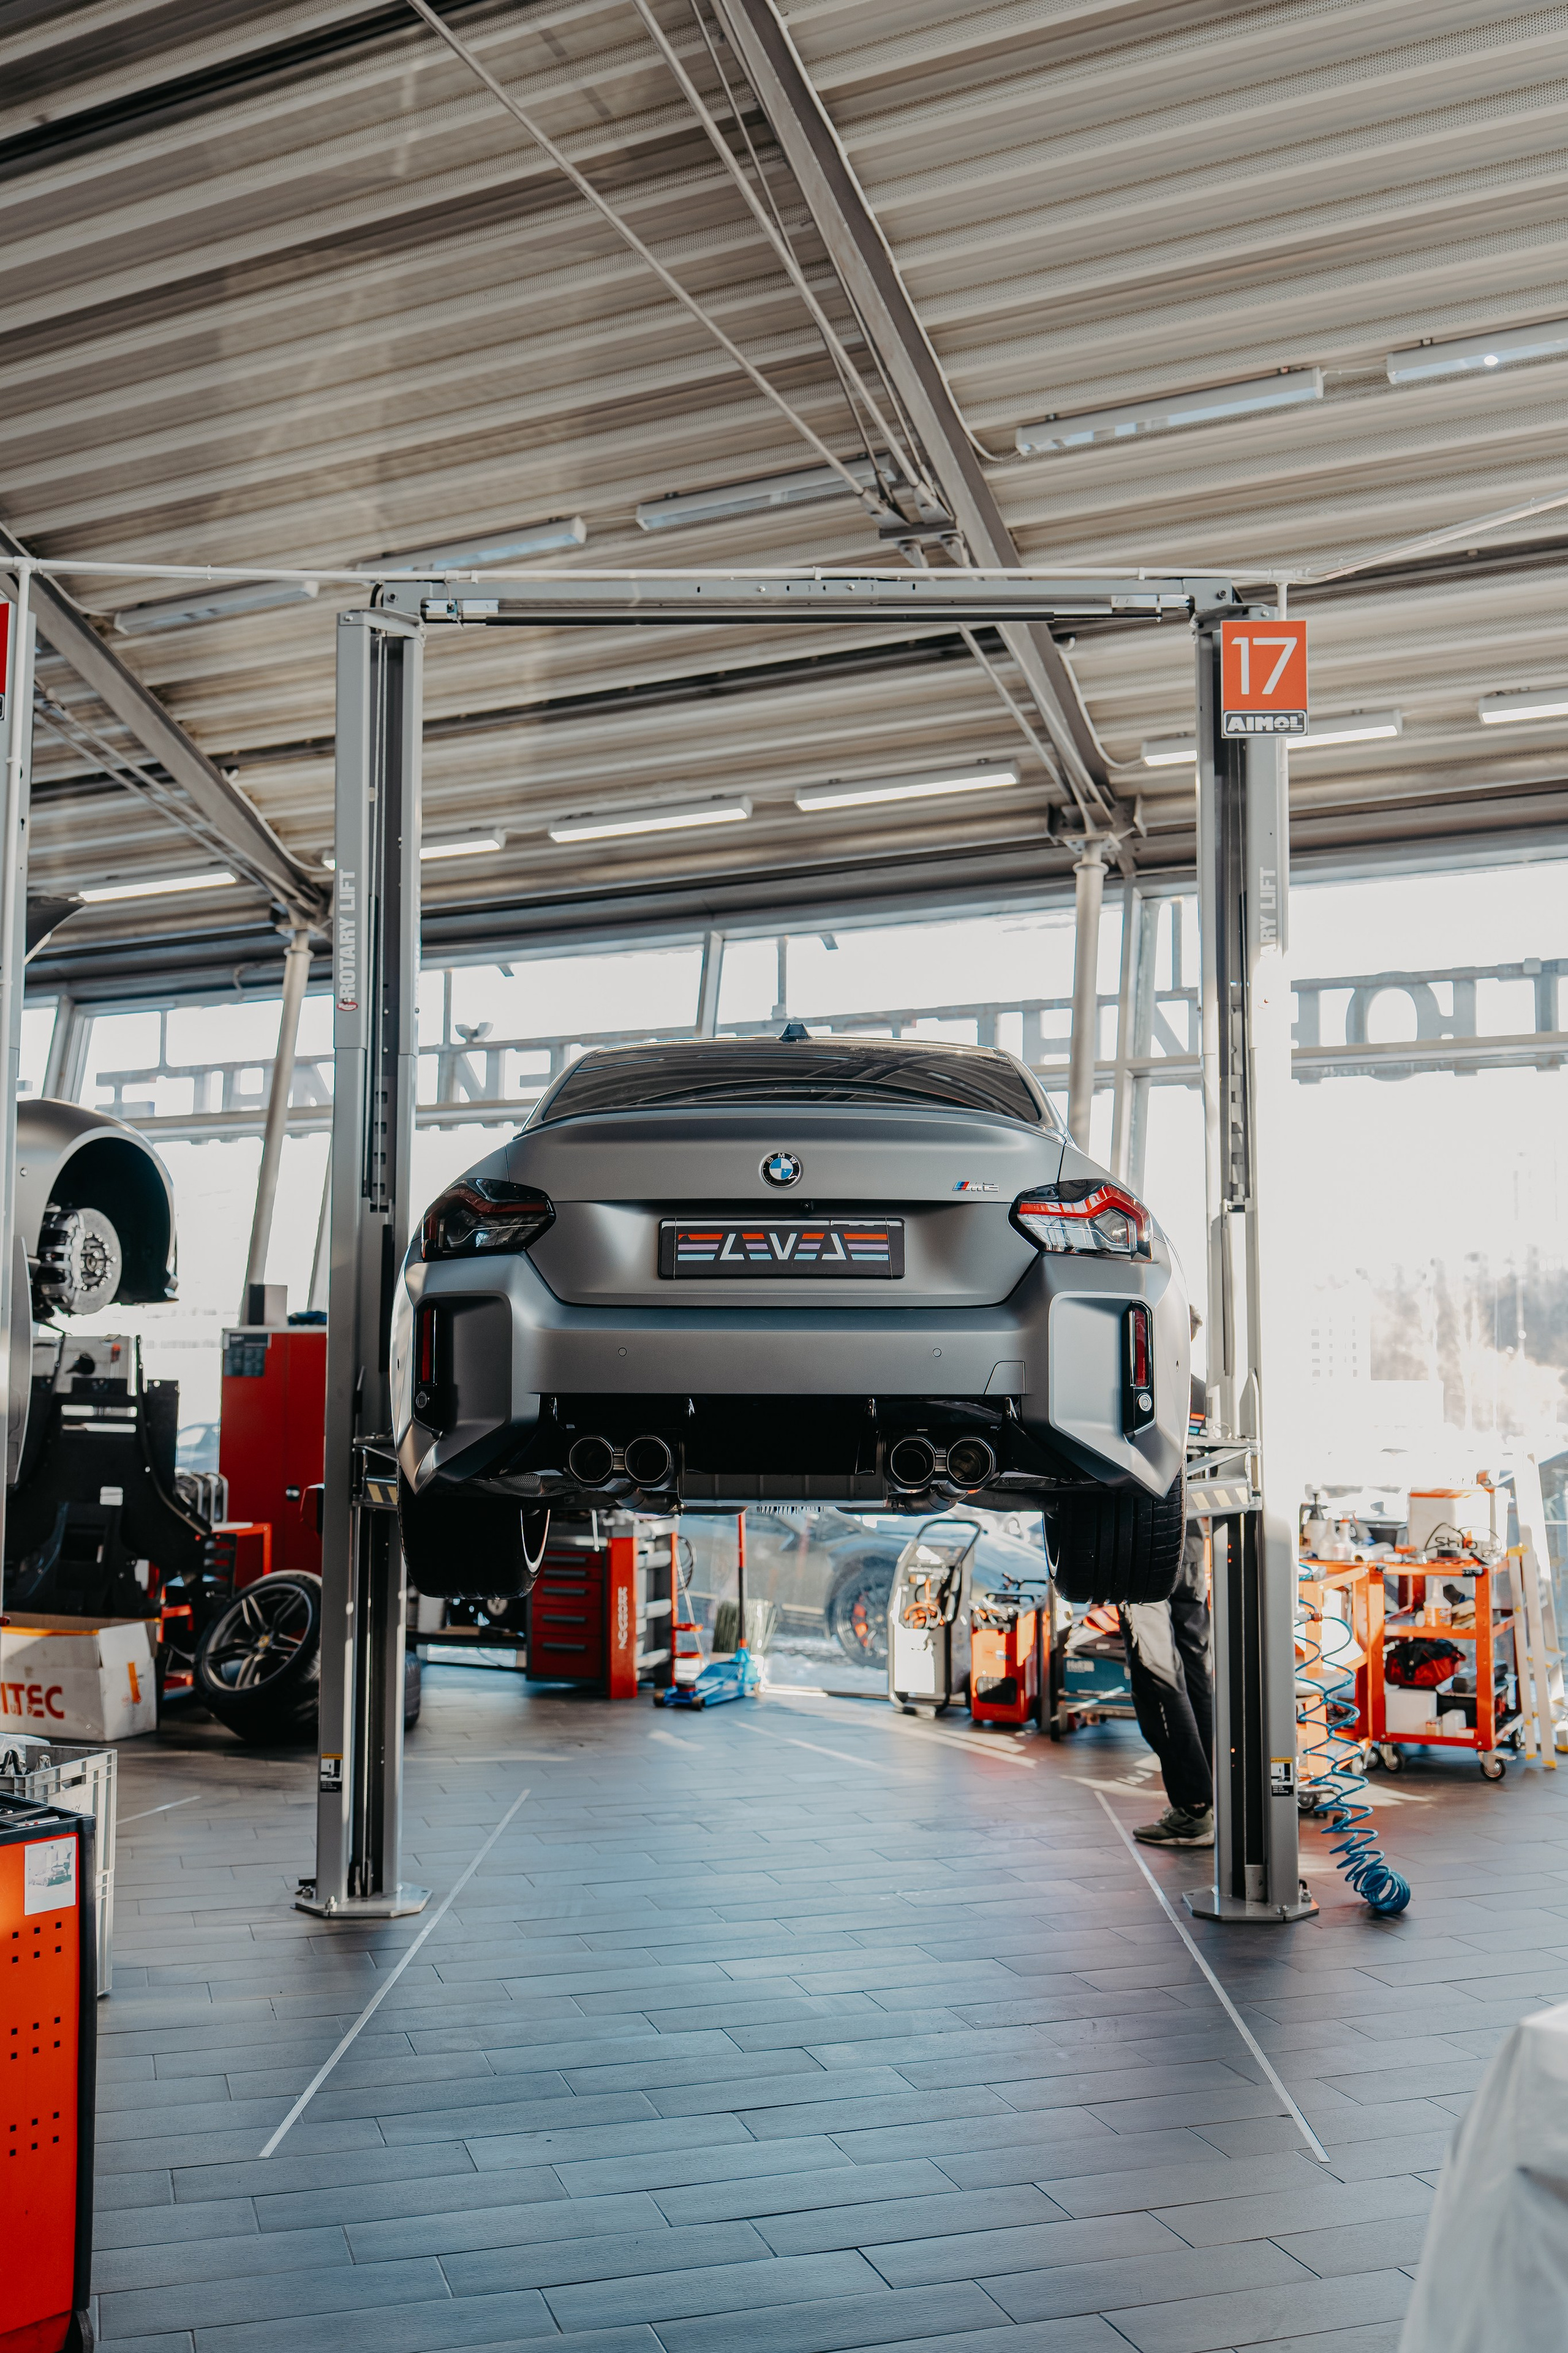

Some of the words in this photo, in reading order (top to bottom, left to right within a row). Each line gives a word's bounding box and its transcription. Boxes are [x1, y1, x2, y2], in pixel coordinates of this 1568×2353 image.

[1231, 636, 1297, 695] 17
[339, 869, 355, 911] LIFT
[1259, 867, 1276, 909] LIFT
[339, 918, 356, 999] ROTARY
[766, 1153, 797, 1164] BMW
